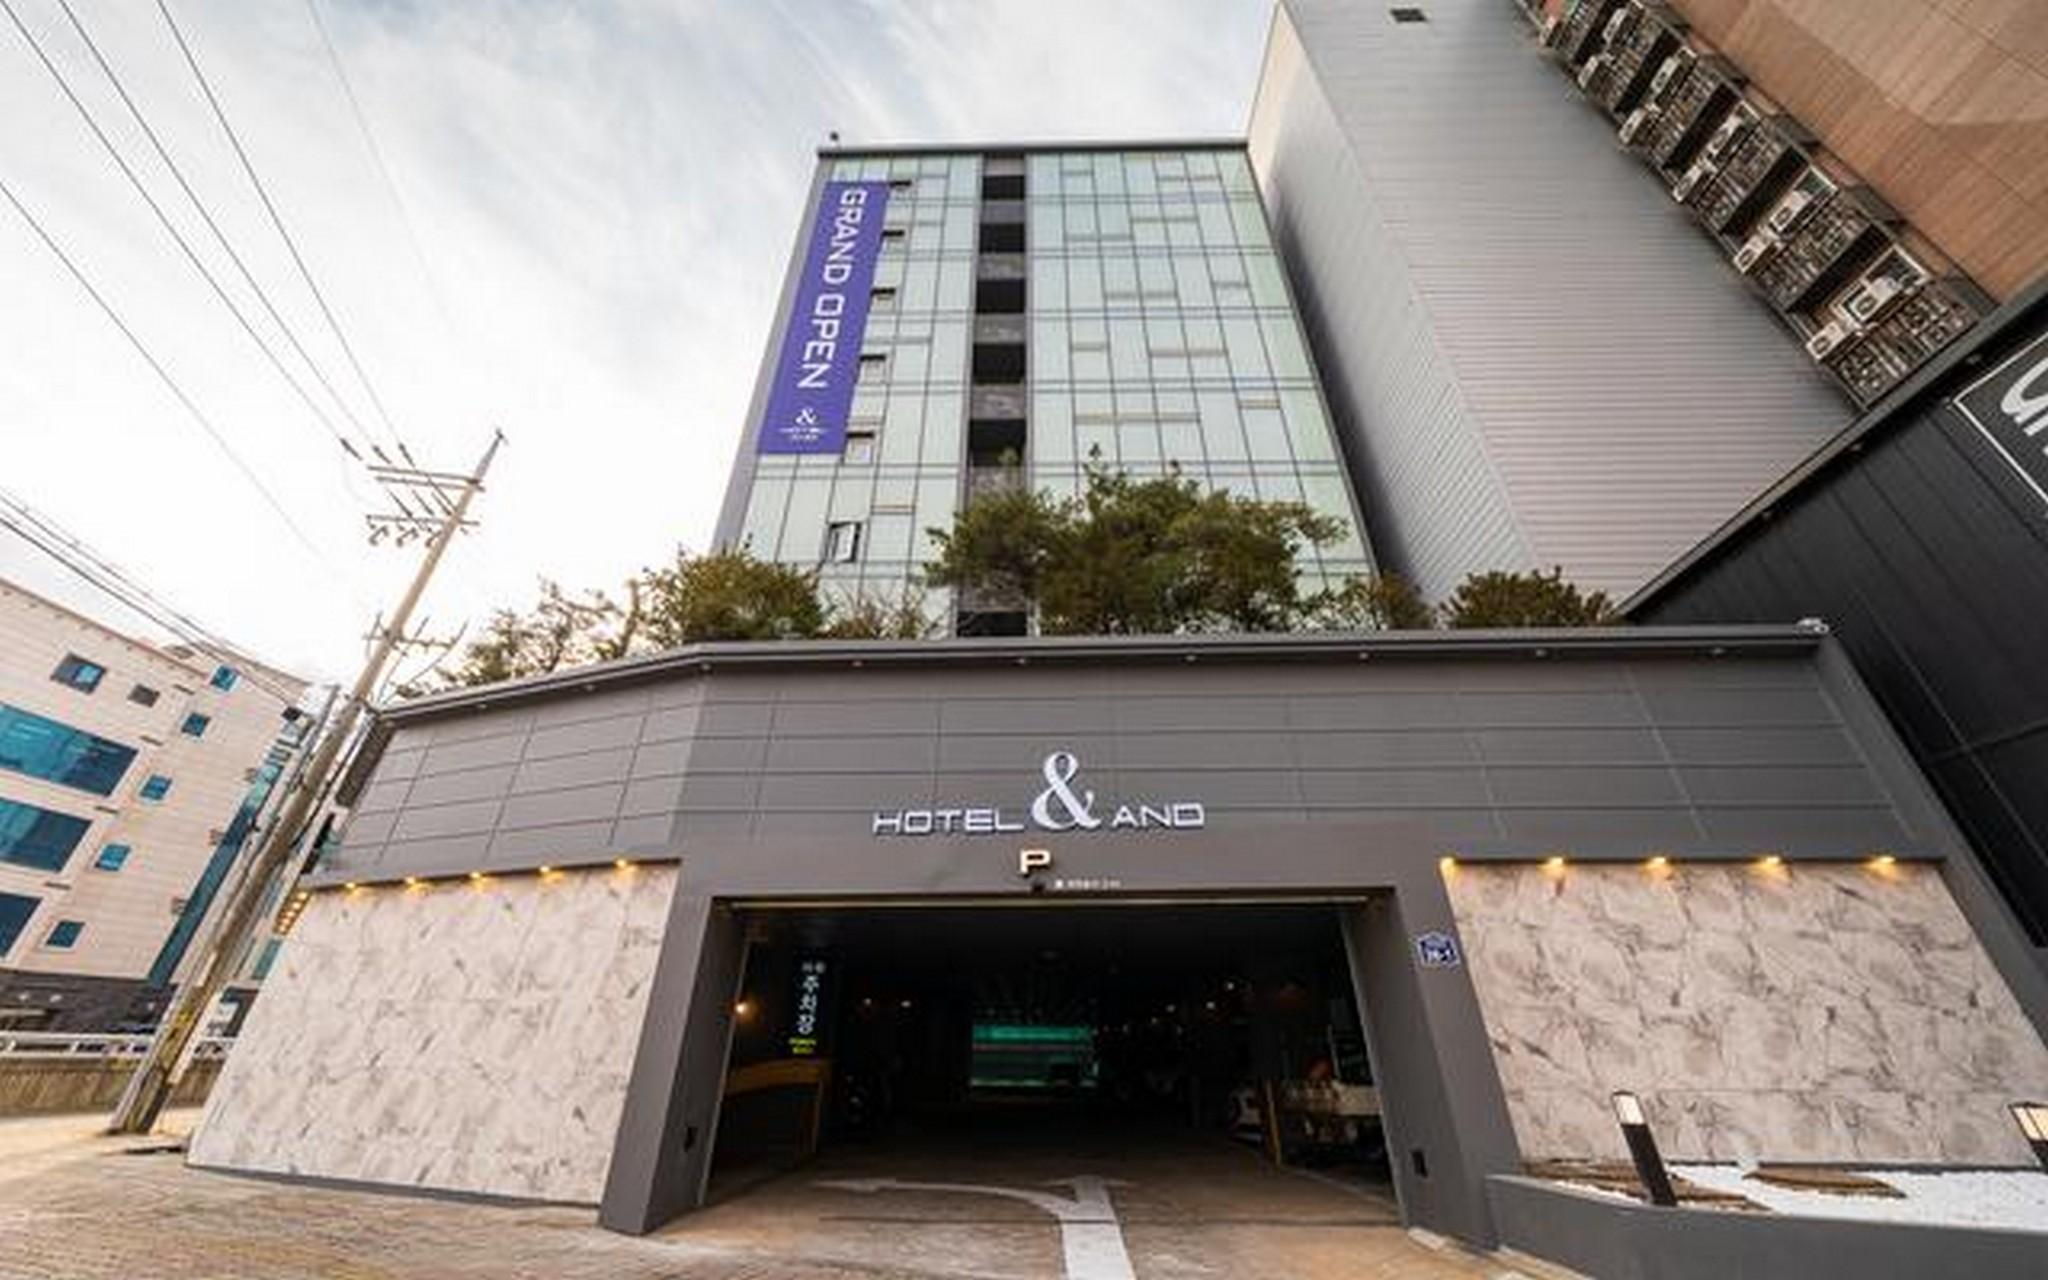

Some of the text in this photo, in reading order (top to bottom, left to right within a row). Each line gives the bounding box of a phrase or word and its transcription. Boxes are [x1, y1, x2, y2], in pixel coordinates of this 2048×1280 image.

[822, 187, 868, 285] GRAND
[796, 294, 846, 388] OPEN
[872, 750, 1205, 835] HOTEL & AND
[1019, 849, 1051, 874] P
